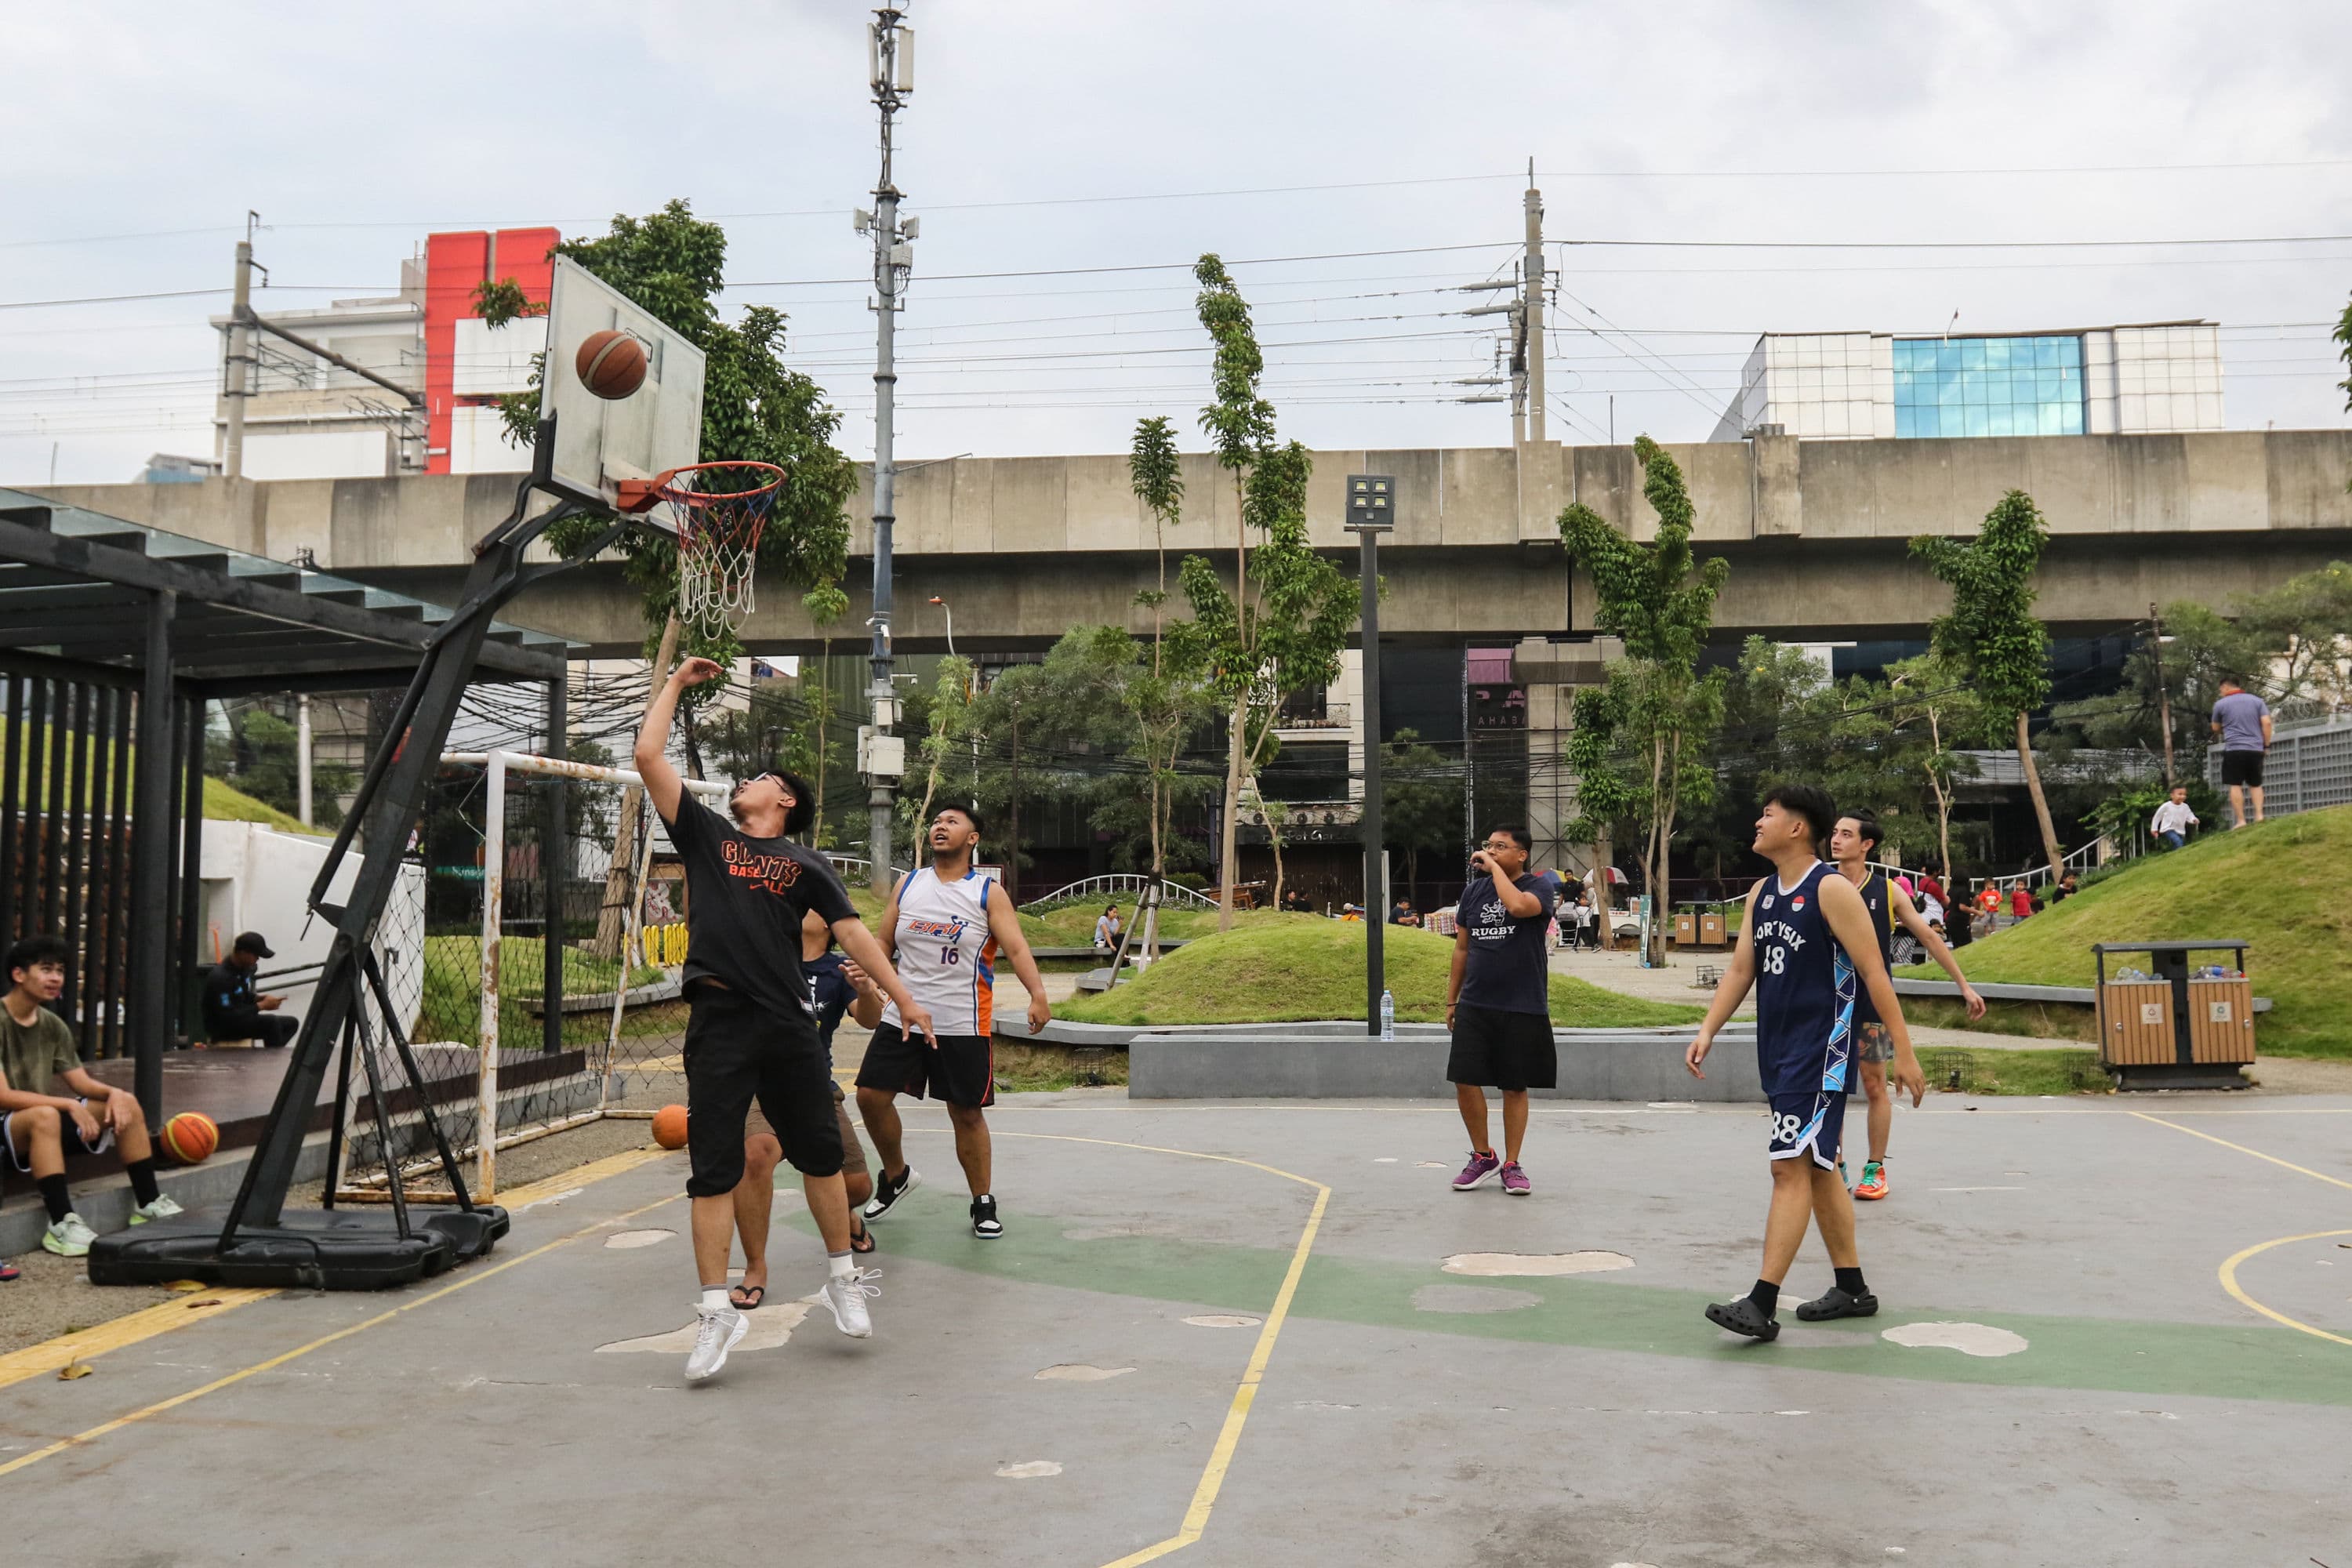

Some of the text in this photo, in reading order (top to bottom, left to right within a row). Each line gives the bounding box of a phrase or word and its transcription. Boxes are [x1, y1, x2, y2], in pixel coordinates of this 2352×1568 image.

[909, 919, 962, 935] BRI
[1471, 925, 1516, 936] RUGBY
[1754, 920, 1806, 952] ORYSIX
[941, 946, 959, 965] 16
[1772, 1111, 1801, 1144] 88
